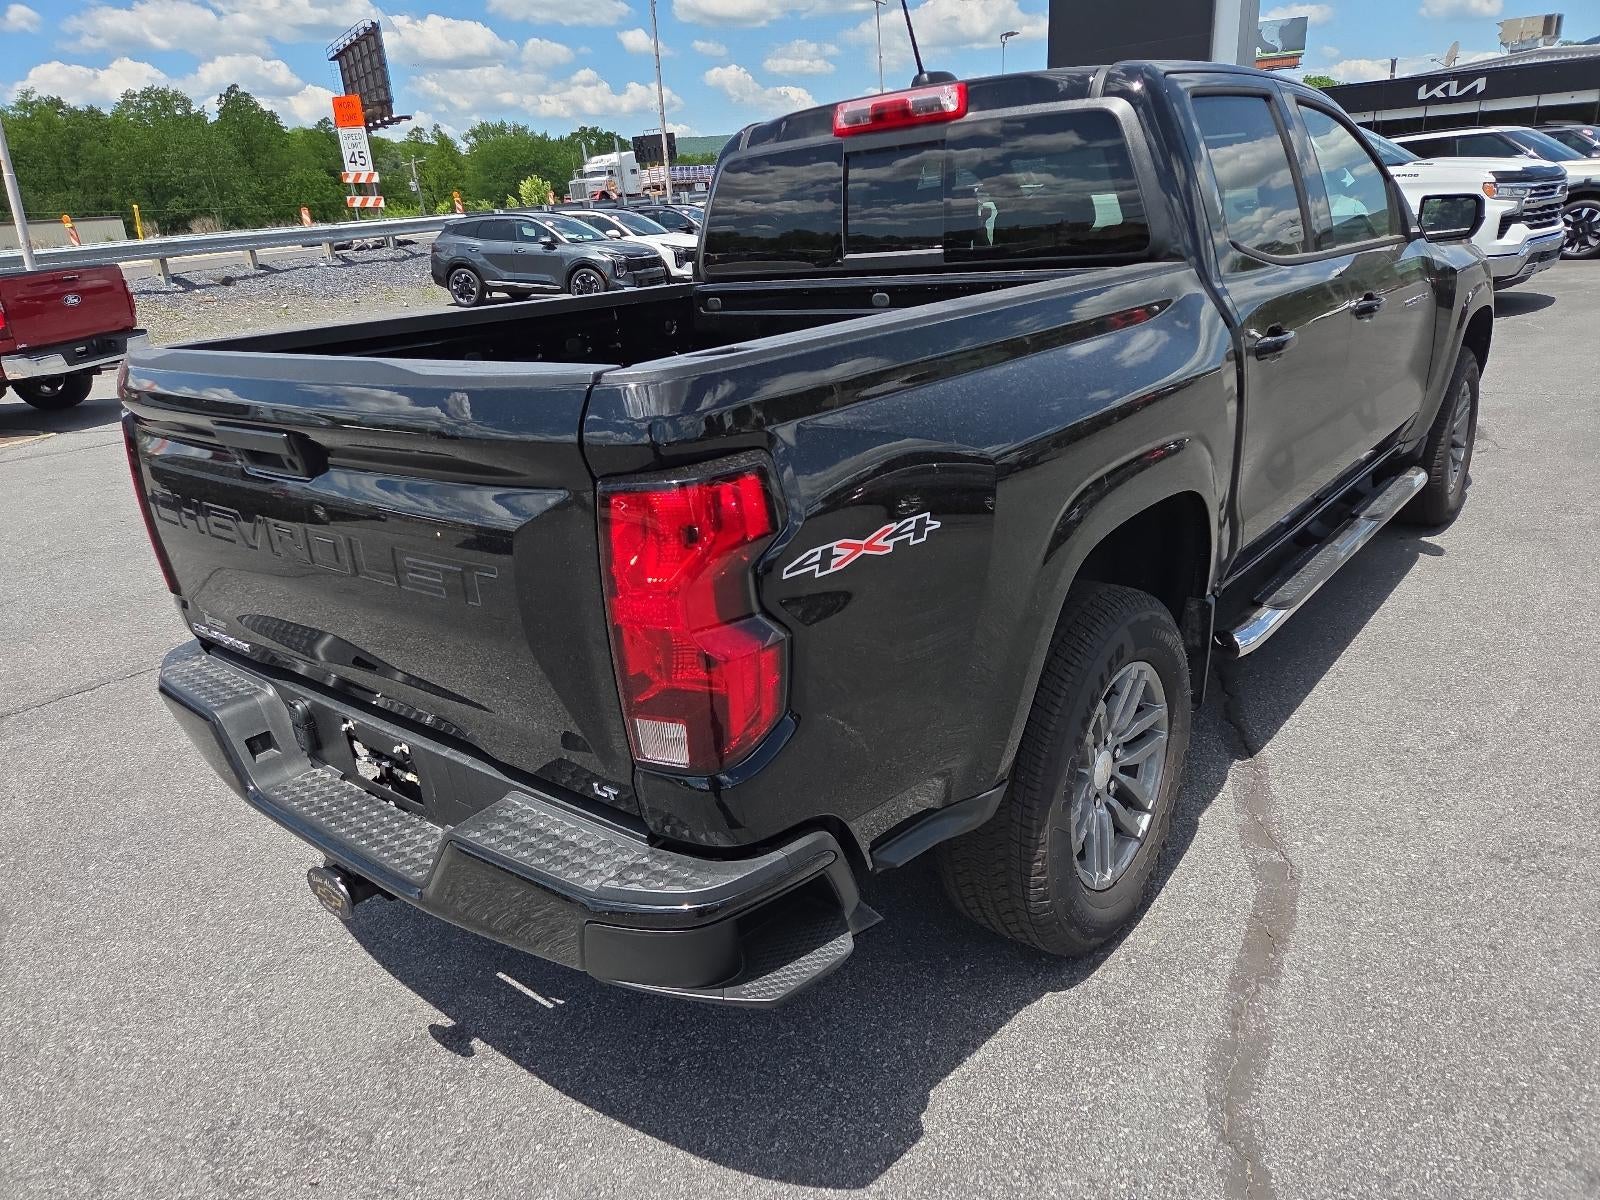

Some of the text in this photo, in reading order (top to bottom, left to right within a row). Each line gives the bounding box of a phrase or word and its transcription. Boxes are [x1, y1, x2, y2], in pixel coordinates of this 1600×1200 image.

[1417, 76, 1487, 100] KIA
[338, 101, 356, 110] WORK
[341, 113, 358, 122] ZONE
[343, 132, 363, 141] SPEED
[346, 142, 362, 150] LIMIT
[349, 150, 367, 167] 45
[150, 488, 498, 607] CHEVROLET
[592, 782, 619, 801] LT
